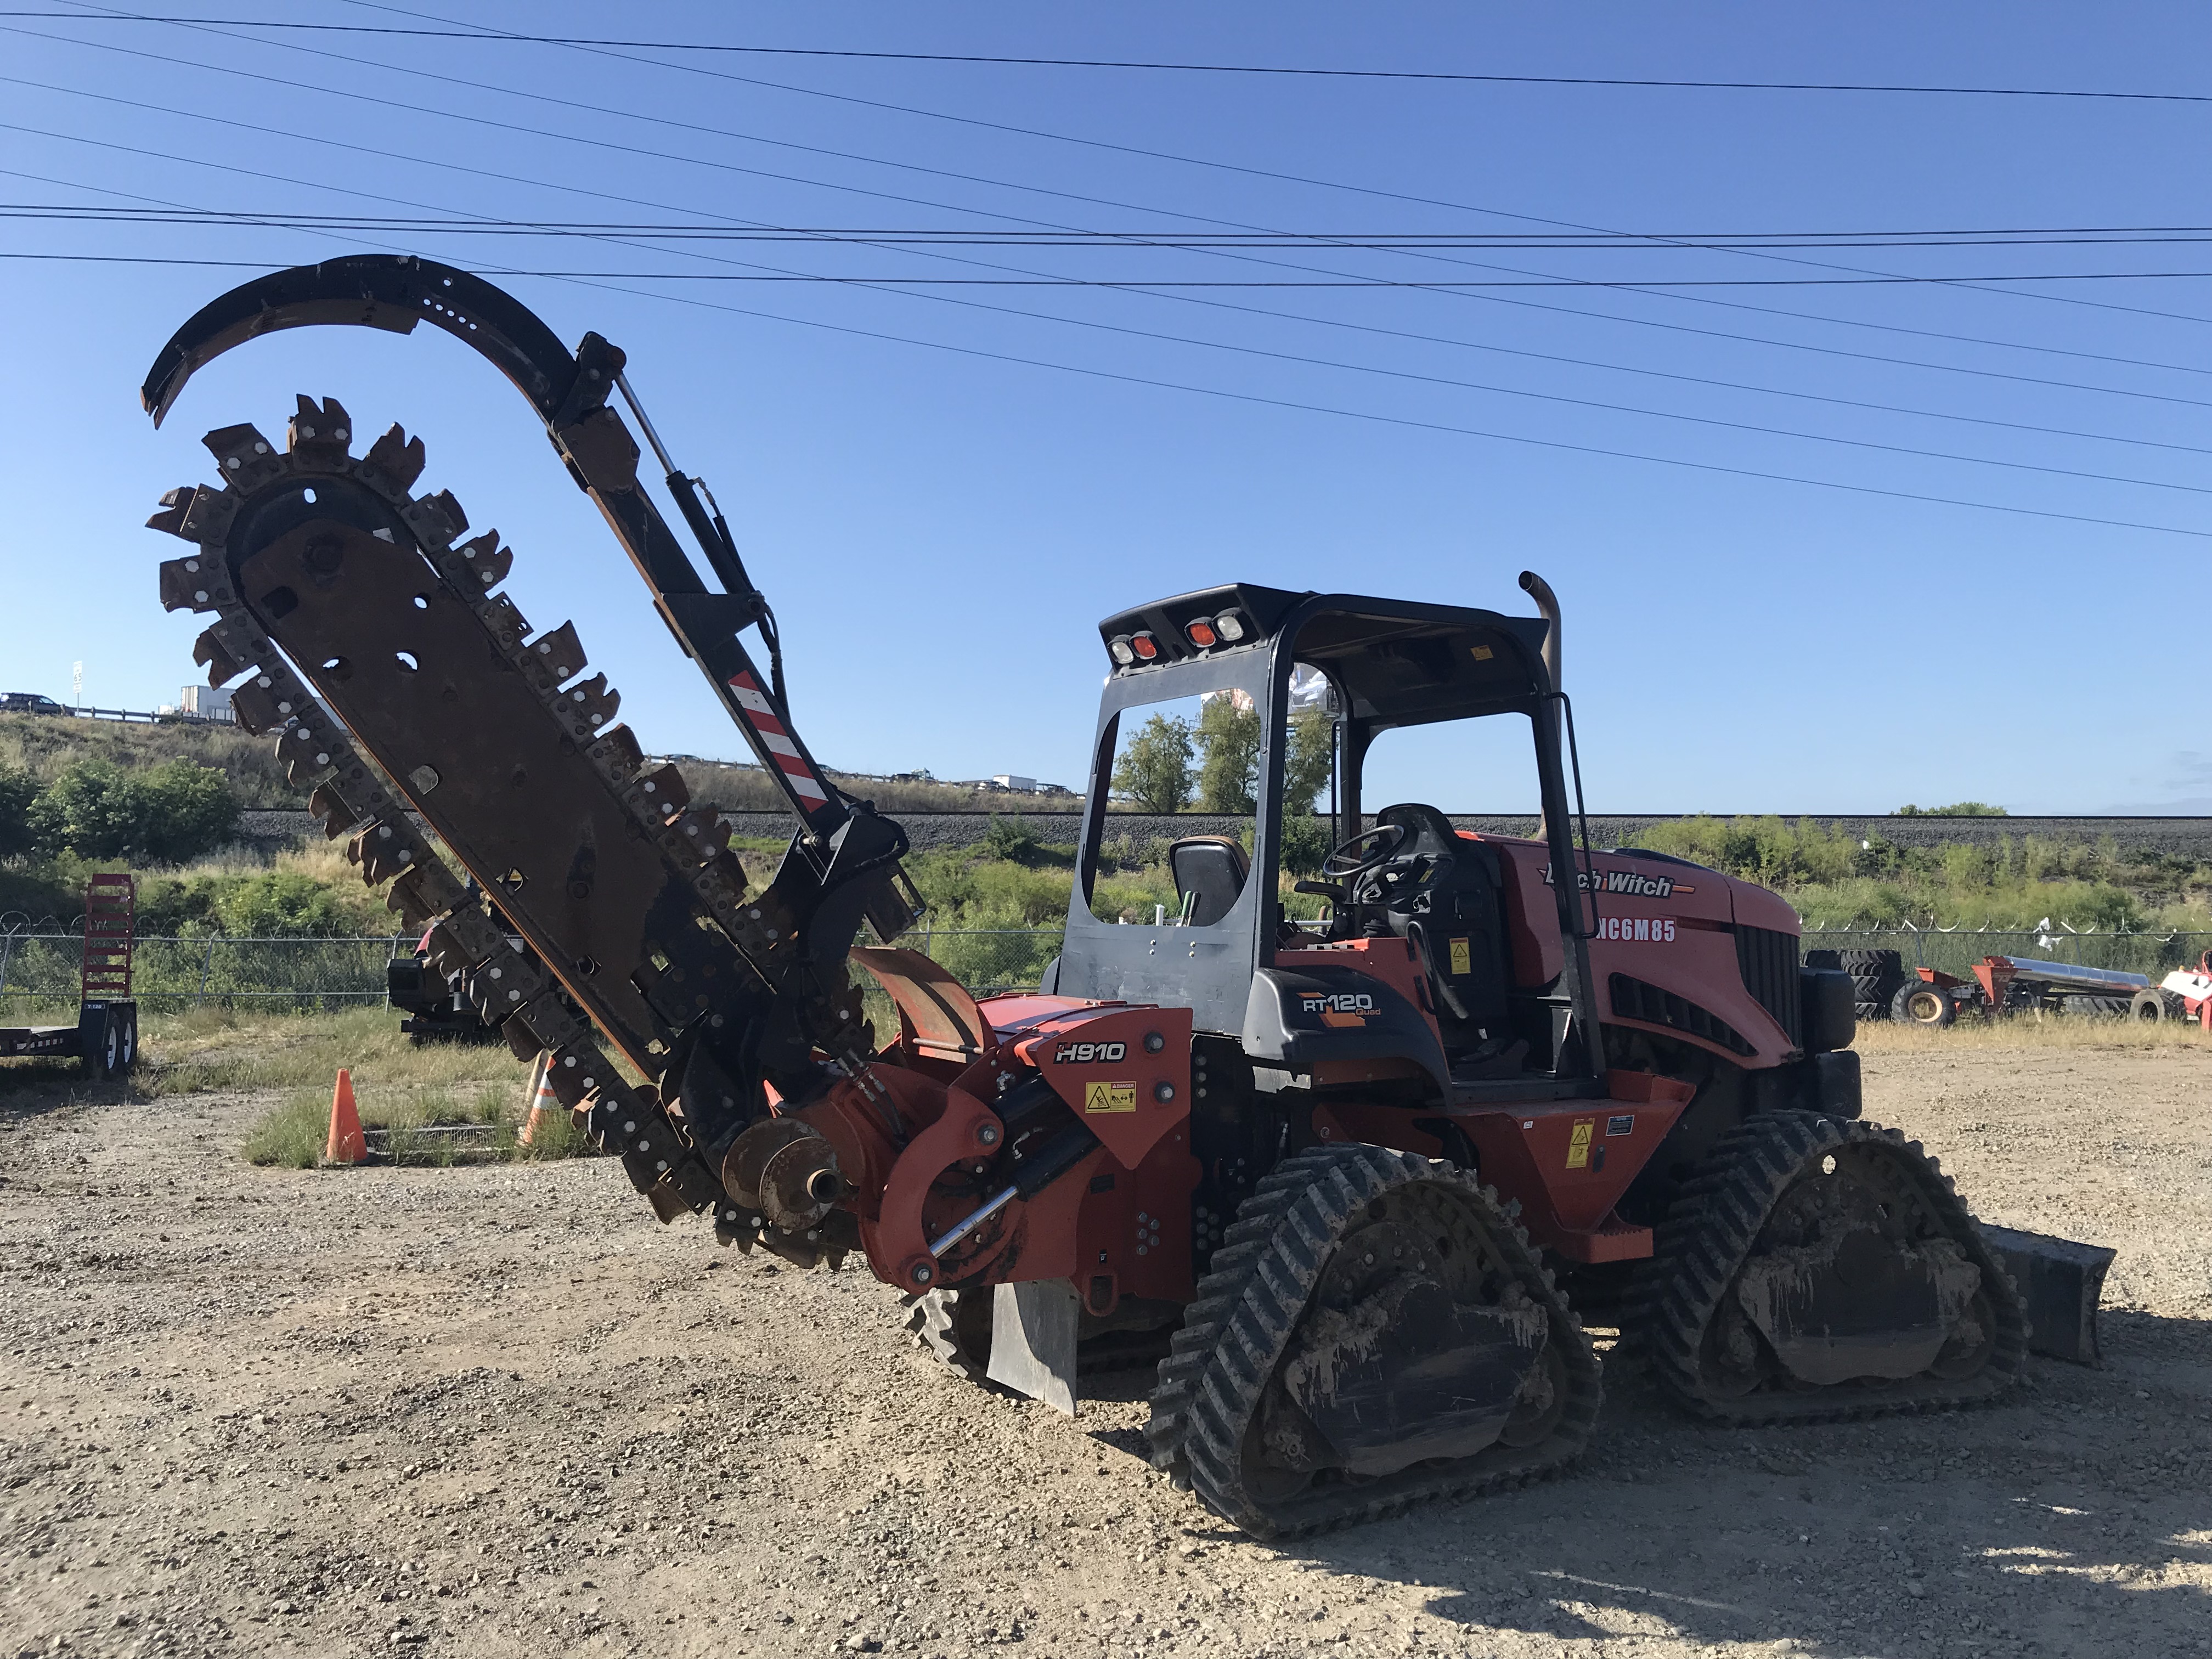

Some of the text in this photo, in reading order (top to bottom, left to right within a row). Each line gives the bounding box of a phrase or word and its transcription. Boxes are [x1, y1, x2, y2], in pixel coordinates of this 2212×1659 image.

[74, 673, 82, 682] 65
[1607, 872, 1672, 896] Witch
[1596, 918, 1675, 942] NC6M85
[1303, 994, 1373, 1012] RT120
[1355, 1008, 1381, 1016] Quad
[1056, 1043, 1126, 1062] H910
